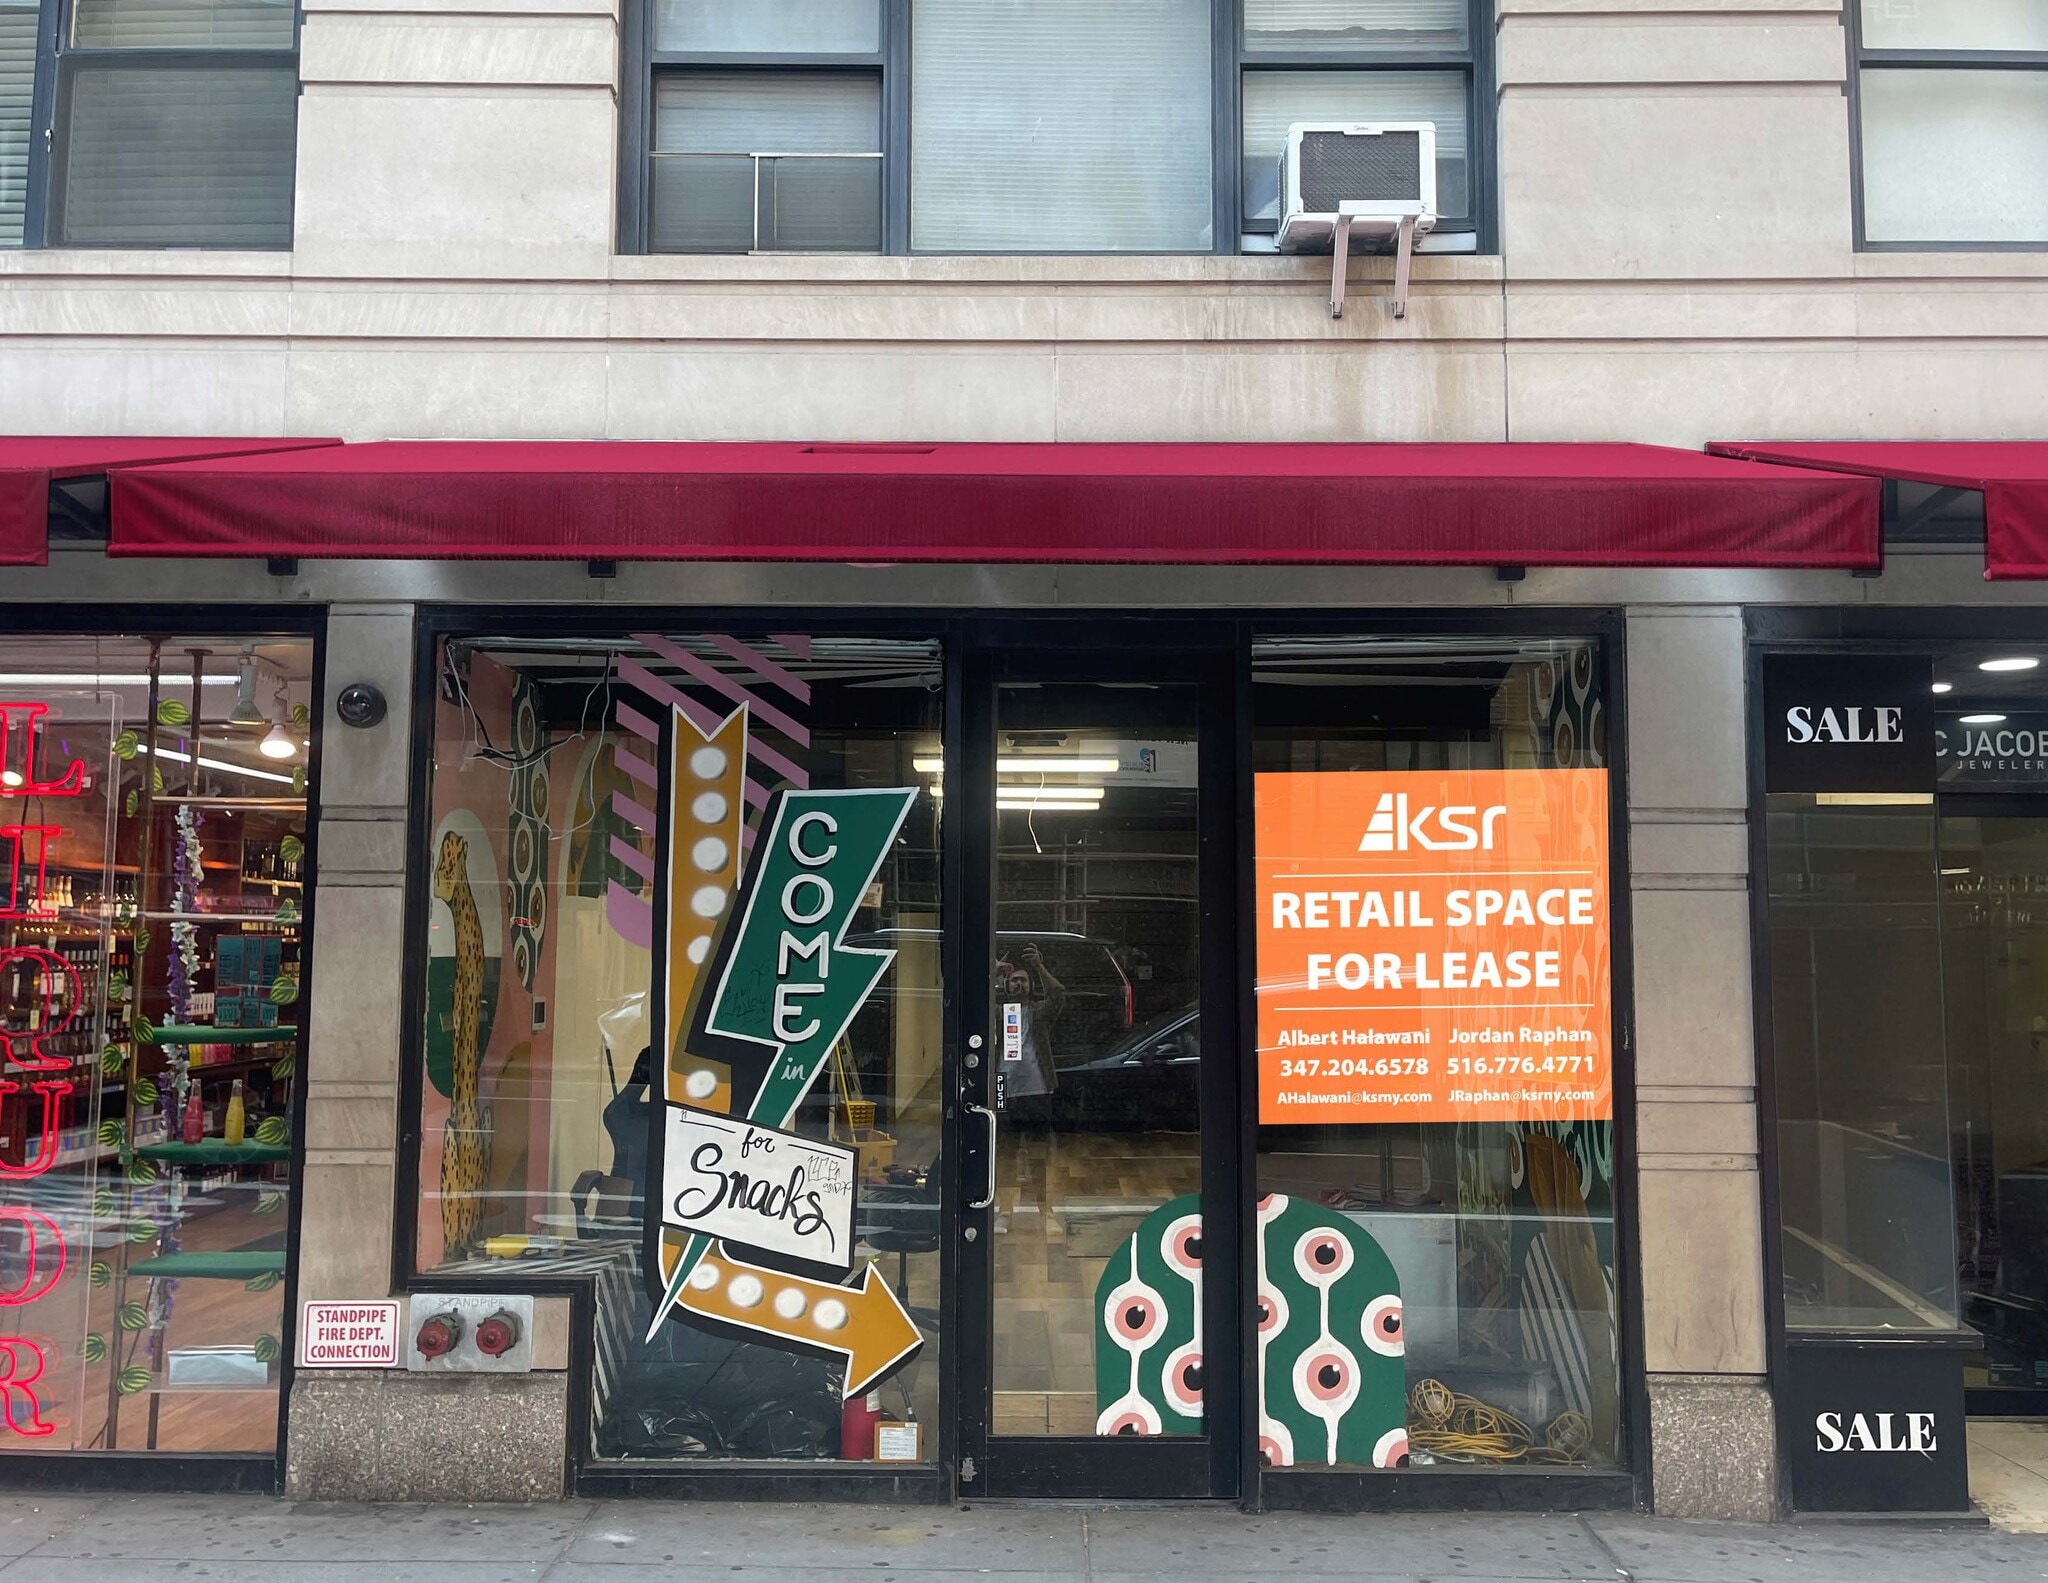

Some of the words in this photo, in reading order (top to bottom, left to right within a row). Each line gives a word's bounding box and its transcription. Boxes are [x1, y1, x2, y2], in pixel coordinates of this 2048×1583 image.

[1786, 706, 1904, 744] SALE
[1957, 760, 2045, 770] JEWELER
[1397, 793, 1507, 851] ksr
[1273, 891, 1434, 929] RETAIL
[1446, 888, 1594, 926] SPACE
[773, 811, 838, 1044] COME
[1307, 953, 1402, 990] FOR
[1415, 951, 1560, 989] LEASE
[1277, 1030, 1338, 1045] Albert
[1342, 1028, 1431, 1046] Halawani
[1448, 1028, 1513, 1043] Jordan
[1519, 1027, 1592, 1045] Raphan
[781, 1056, 806, 1084] in
[1280, 1058, 1429, 1077] 347.204.6578
[1447, 1056, 1594, 1075] 516.776.4771
[1448, 1088, 1594, 1103] JRaphan@ksrny.com
[741, 1127, 776, 1159] for
[673, 1142, 836, 1253] Snacks
[317, 1310, 386, 1323] STANDPIPE
[318, 1327, 346, 1341] FIRE
[349, 1326, 384, 1341] DEPT.
[310, 1345, 390, 1358] CONNECTION
[1815, 1412, 1937, 1452] SALE
